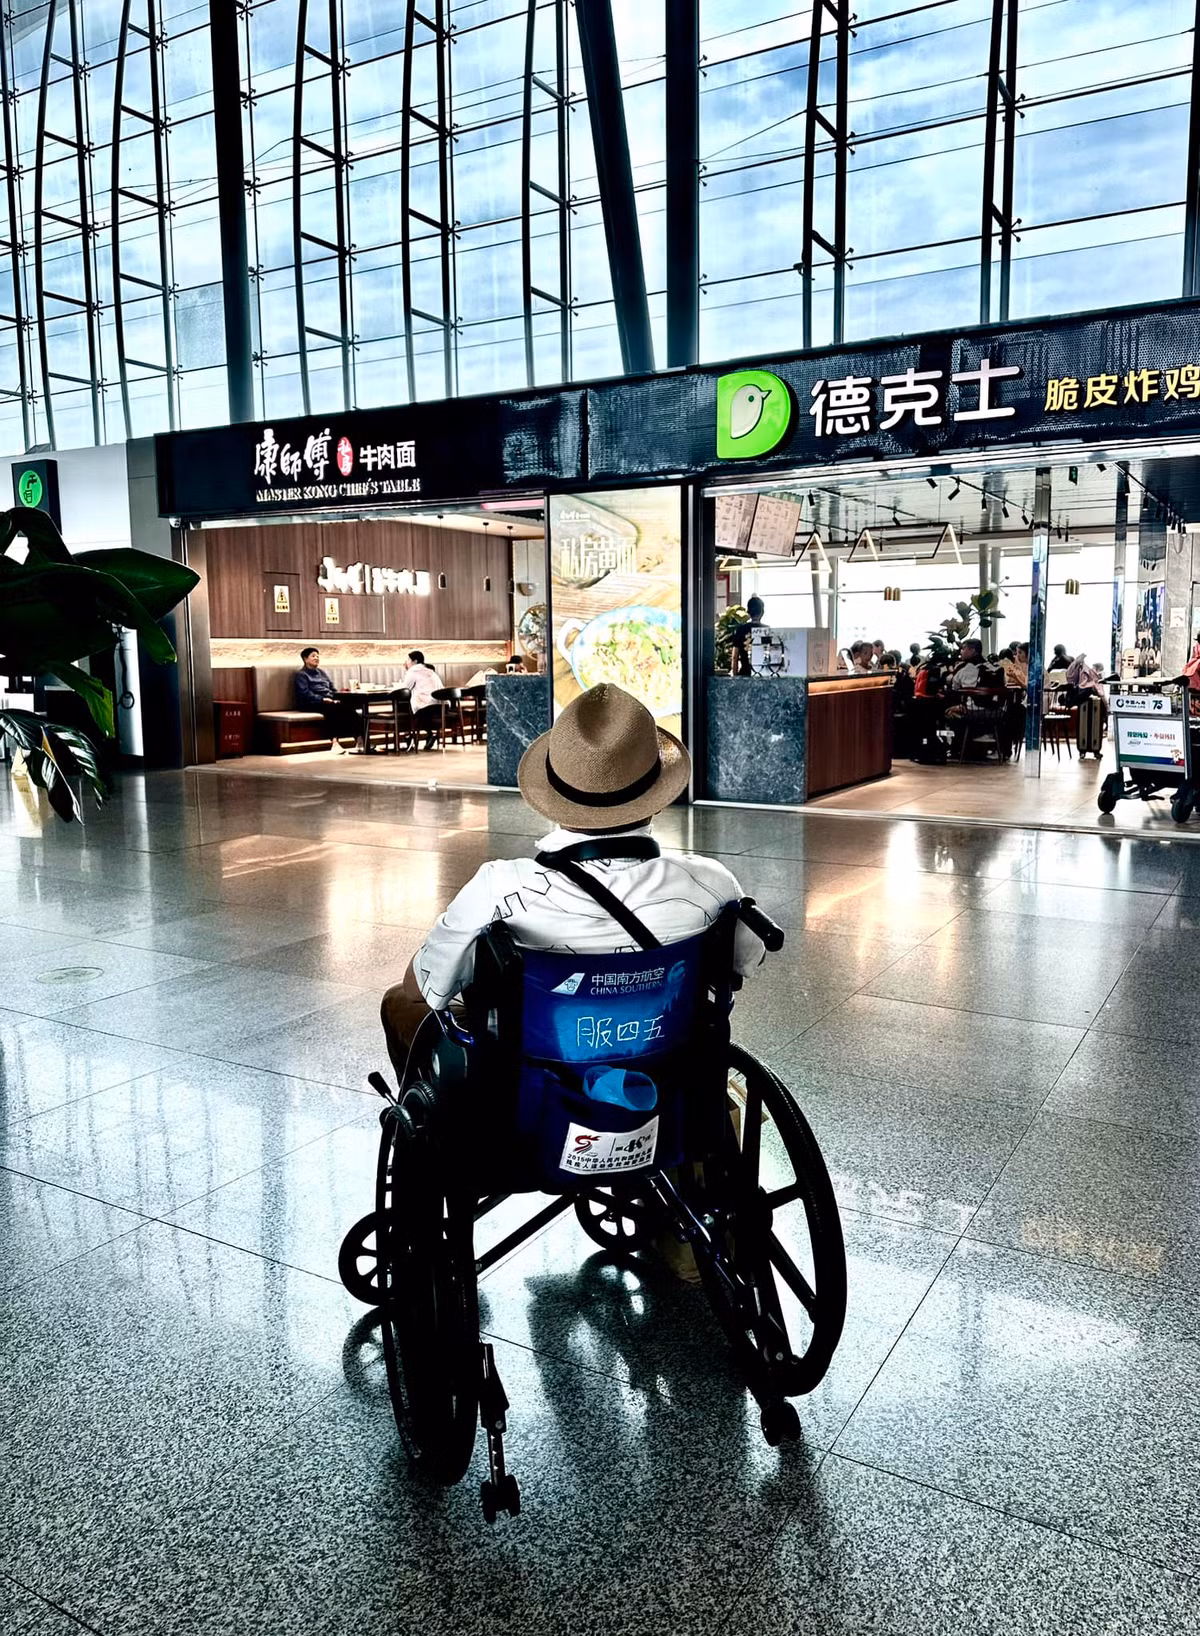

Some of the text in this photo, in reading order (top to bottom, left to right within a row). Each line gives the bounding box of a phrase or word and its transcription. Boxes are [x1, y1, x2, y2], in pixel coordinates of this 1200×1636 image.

[808, 358, 1023, 437] 德克士
[1043, 364, 1200, 412] 脆皮炸鸡
[359, 440, 416, 472] 牛肉面
[256, 487, 302, 502] MASTER
[303, 484, 337, 499] KONG
[379, 477, 421, 494] TABLE
[590, 980, 662, 996] CHINA SOUTHERN
[591, 967, 665, 987] 中国南方航空
[576, 1015, 665, 1049] 服四五
